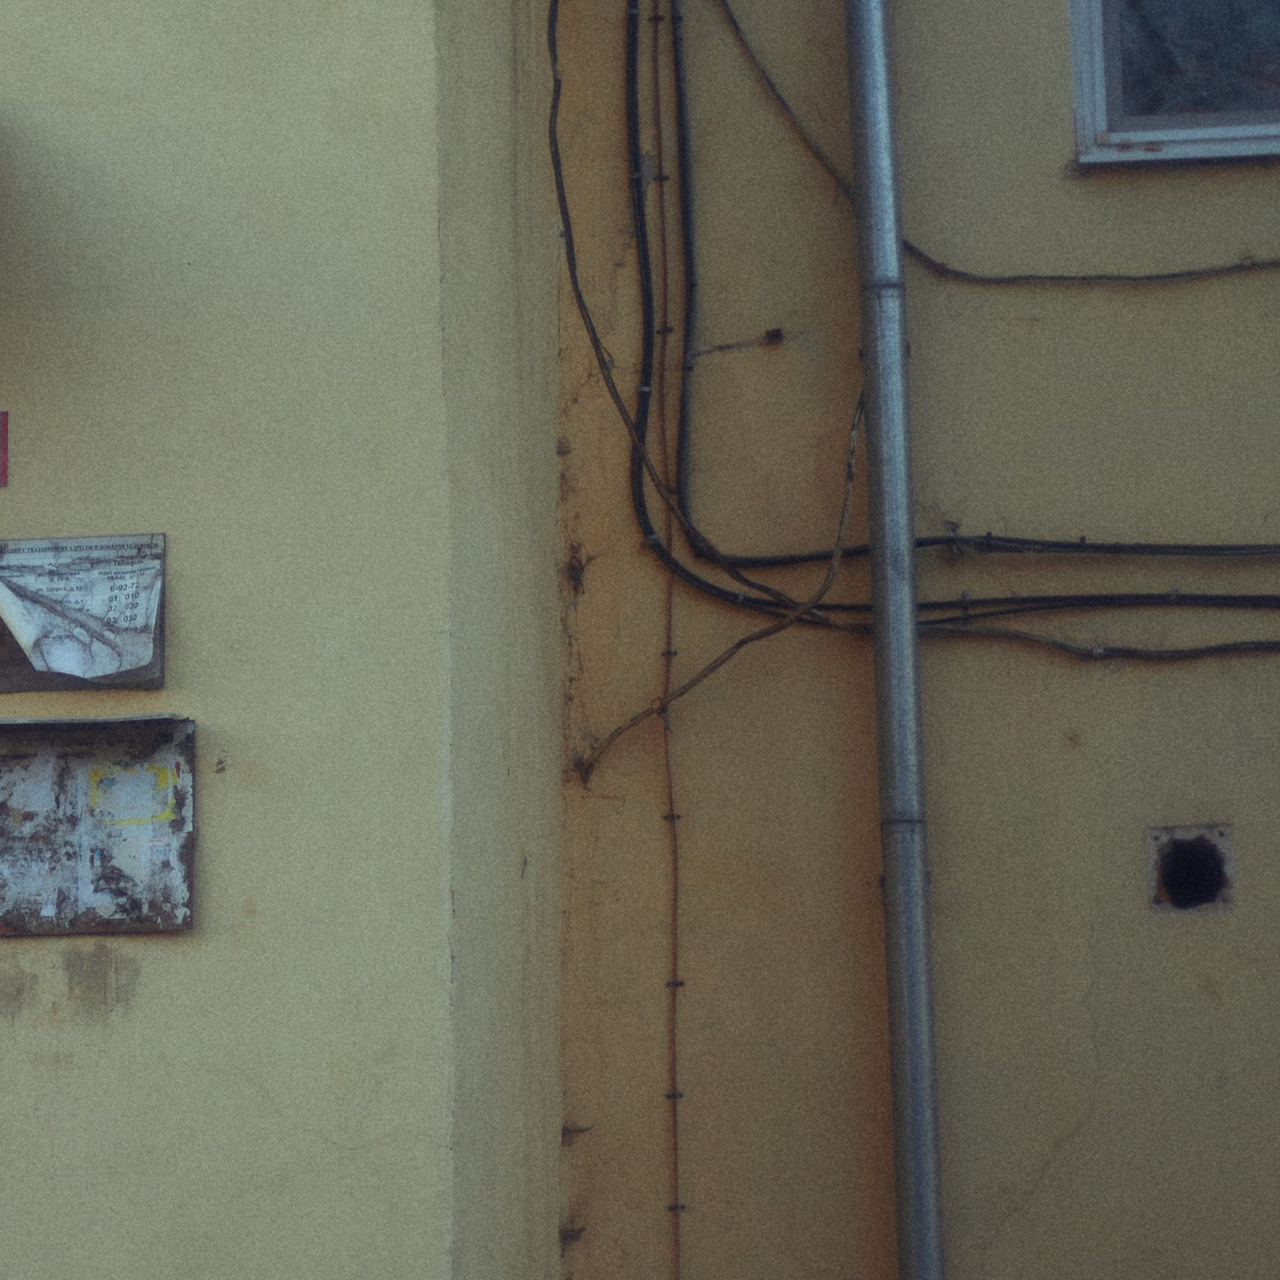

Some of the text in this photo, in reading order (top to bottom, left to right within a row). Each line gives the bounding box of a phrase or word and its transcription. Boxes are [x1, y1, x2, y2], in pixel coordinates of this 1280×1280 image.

[108, 592, 140, 602] 01 010
[124, 602, 139, 610] 020
